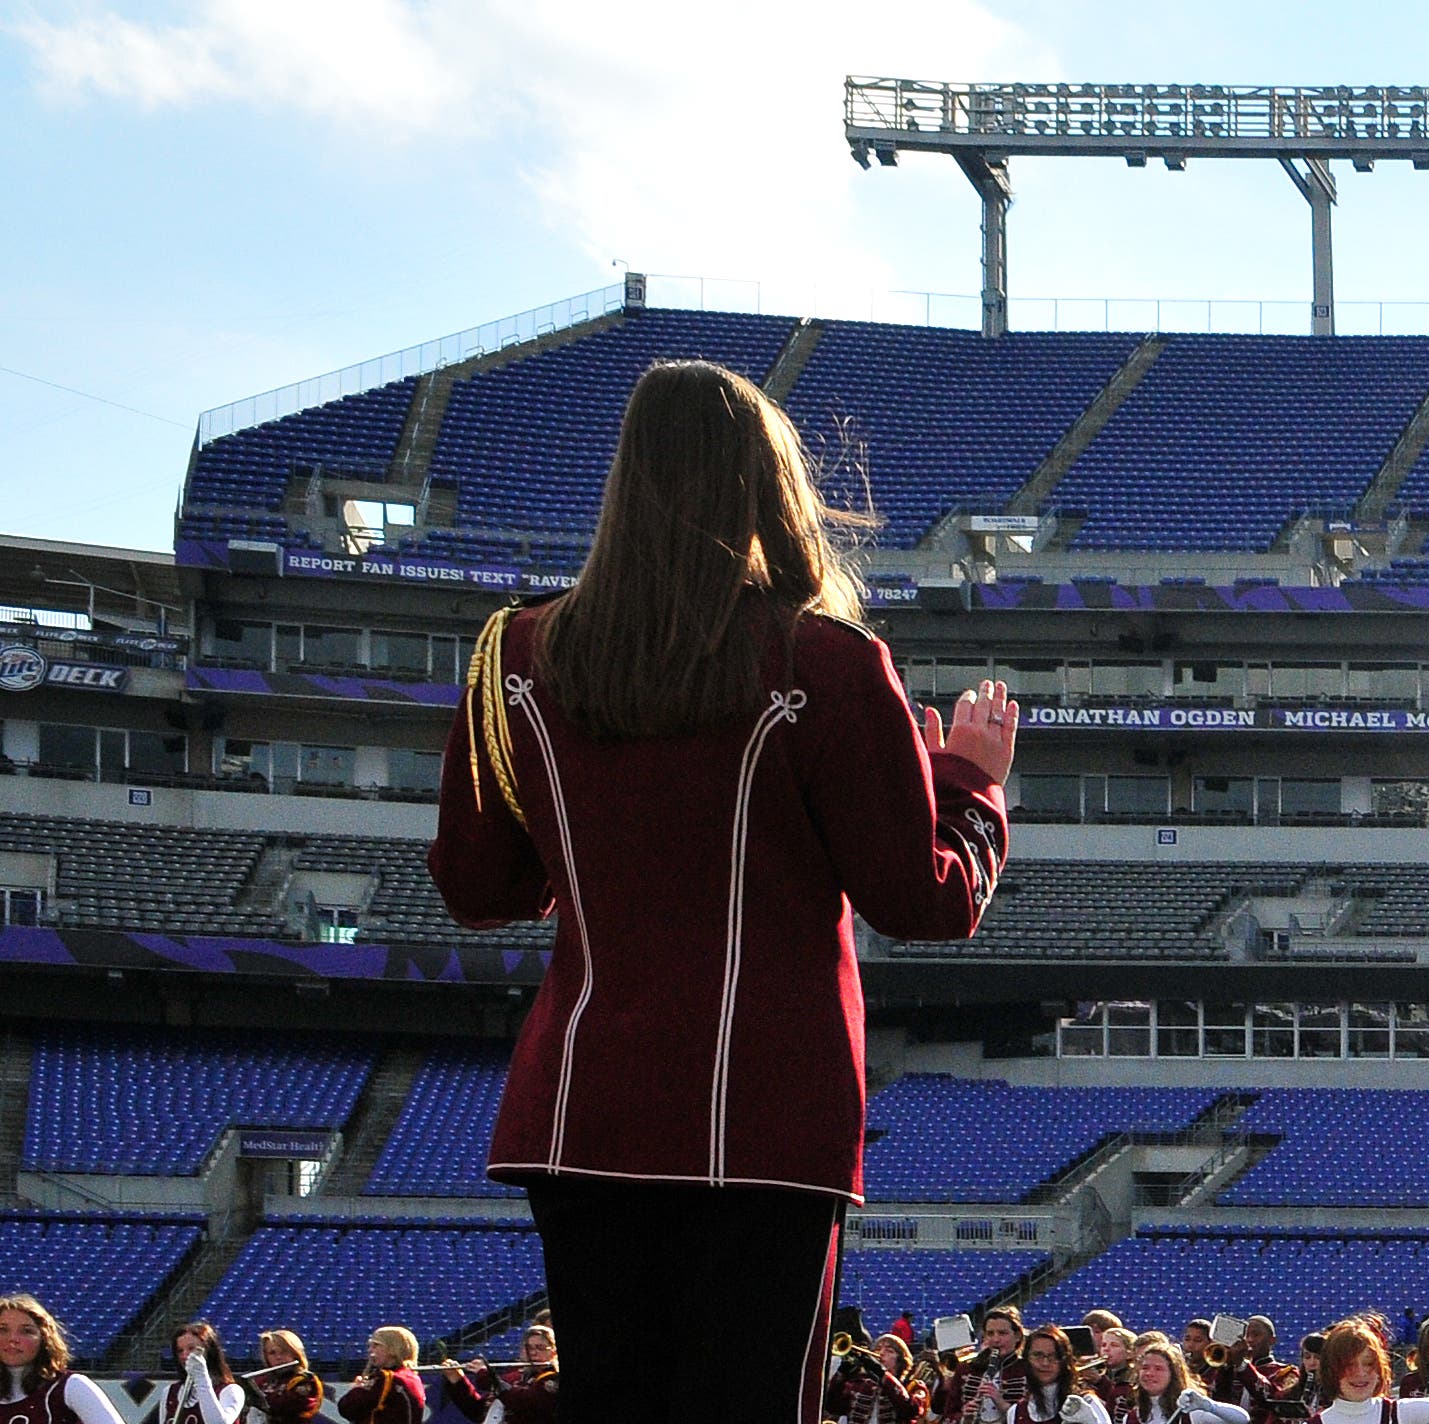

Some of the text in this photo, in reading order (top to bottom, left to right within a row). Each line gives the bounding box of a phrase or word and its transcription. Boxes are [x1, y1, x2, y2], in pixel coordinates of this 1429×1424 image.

[289, 556, 355, 572] REPORT
[362, 562, 393, 575] FAN
[400, 565, 464, 580] ISSUES!
[470, 570, 516, 584] TEXT
[877, 589, 918, 600] 78247
[48, 664, 126, 689] DECK
[1028, 708, 1255, 726] JONATHAN OGDEN
[1285, 711, 1395, 727] MICHAEL
